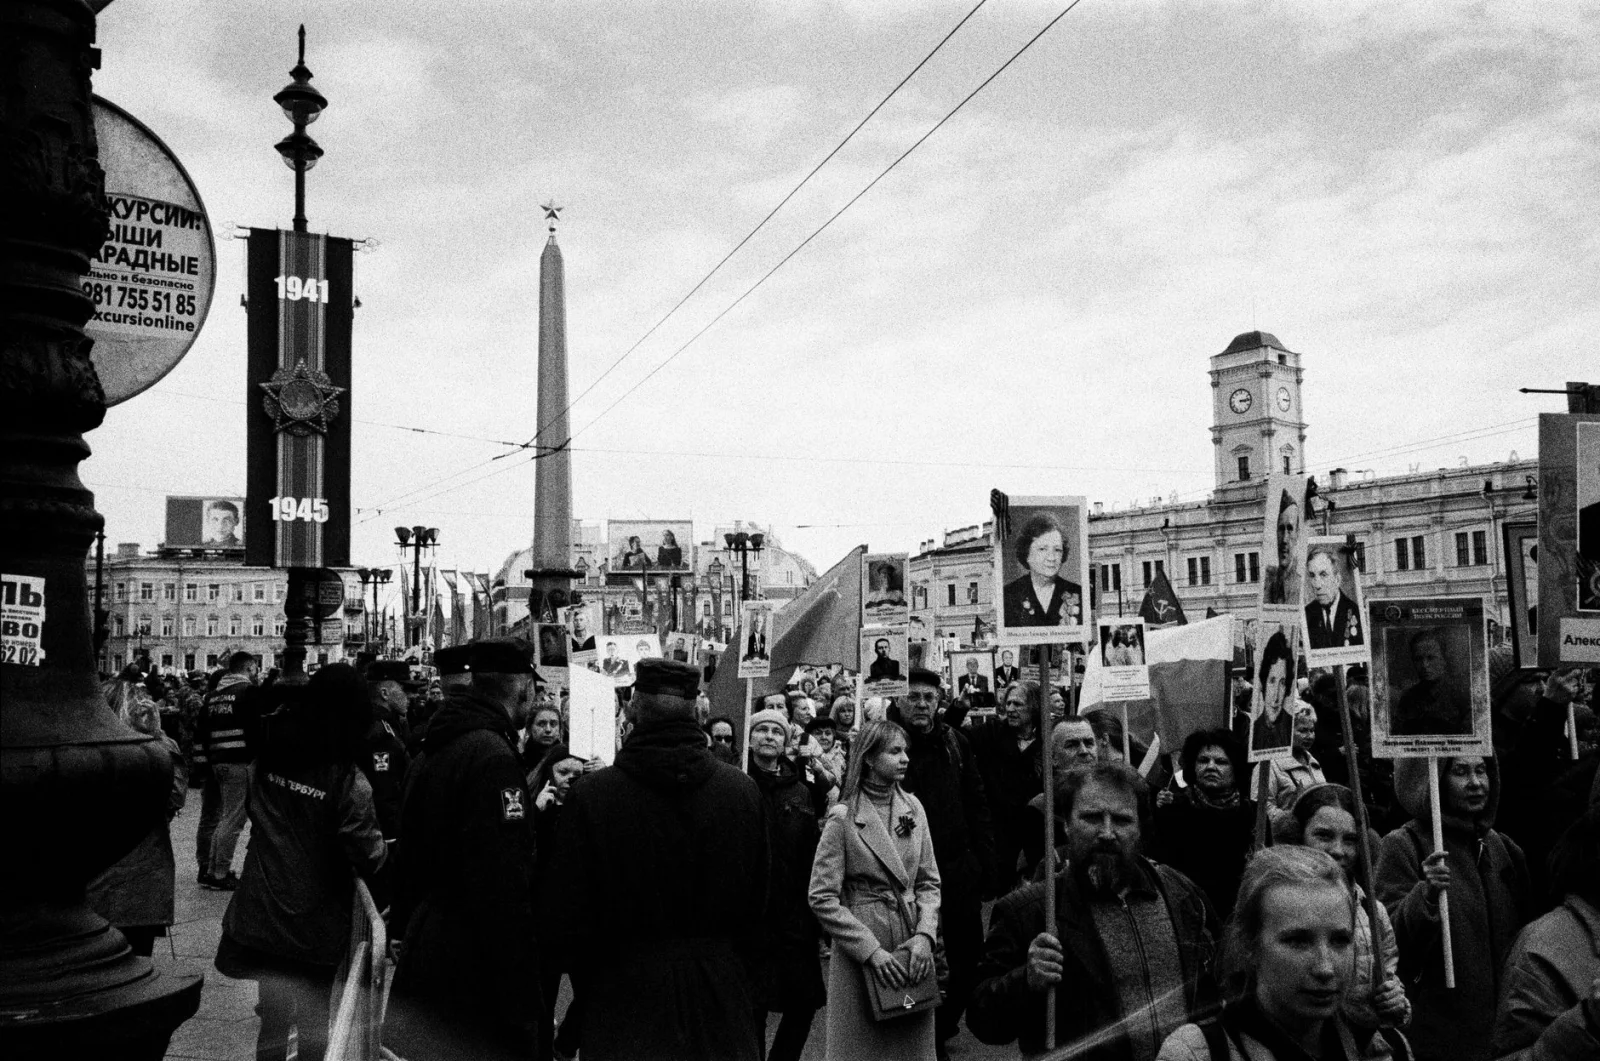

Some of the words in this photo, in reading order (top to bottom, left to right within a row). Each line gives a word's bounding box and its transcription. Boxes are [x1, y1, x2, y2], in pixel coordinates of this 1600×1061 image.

[120, 273, 129, 281] и
[131, 274, 195, 291] безопасно
[273, 275, 330, 304] 1941
[117, 286, 149, 311] 755
[151, 290, 172, 313] 51
[176, 293, 196, 316] 85
[268, 496, 330, 523] 1945
[1, 620, 39, 639] ВО
[20, 646, 37, 666] 02
